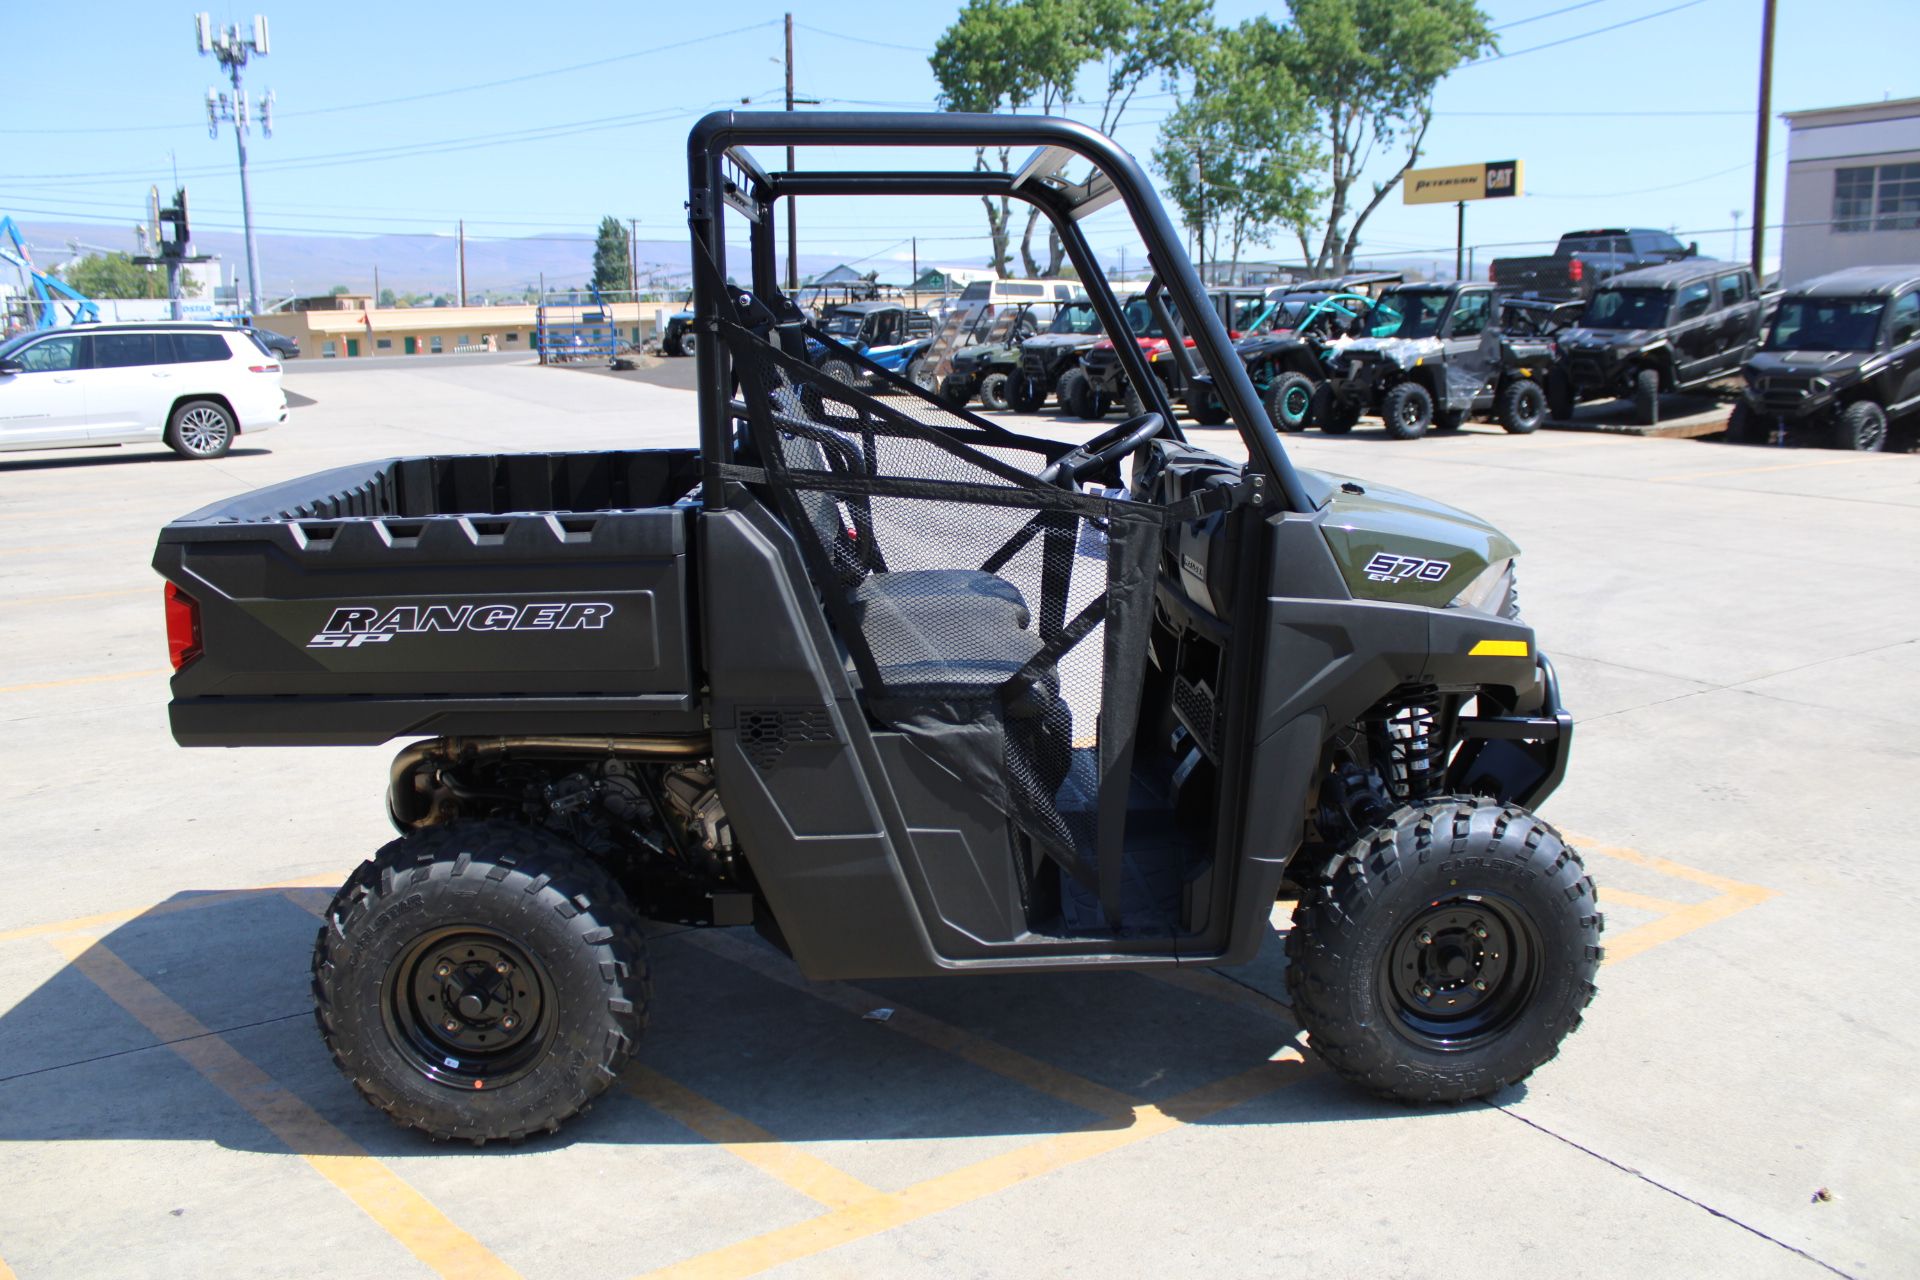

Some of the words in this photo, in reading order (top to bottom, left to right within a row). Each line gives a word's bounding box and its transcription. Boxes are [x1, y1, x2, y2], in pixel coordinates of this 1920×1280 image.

[1487, 168, 1513, 189] CAT
[1363, 552, 1451, 582] 570
[1367, 573, 1401, 584] EFI
[322, 603, 614, 633] RANGER
[306, 633, 395, 647] SP
